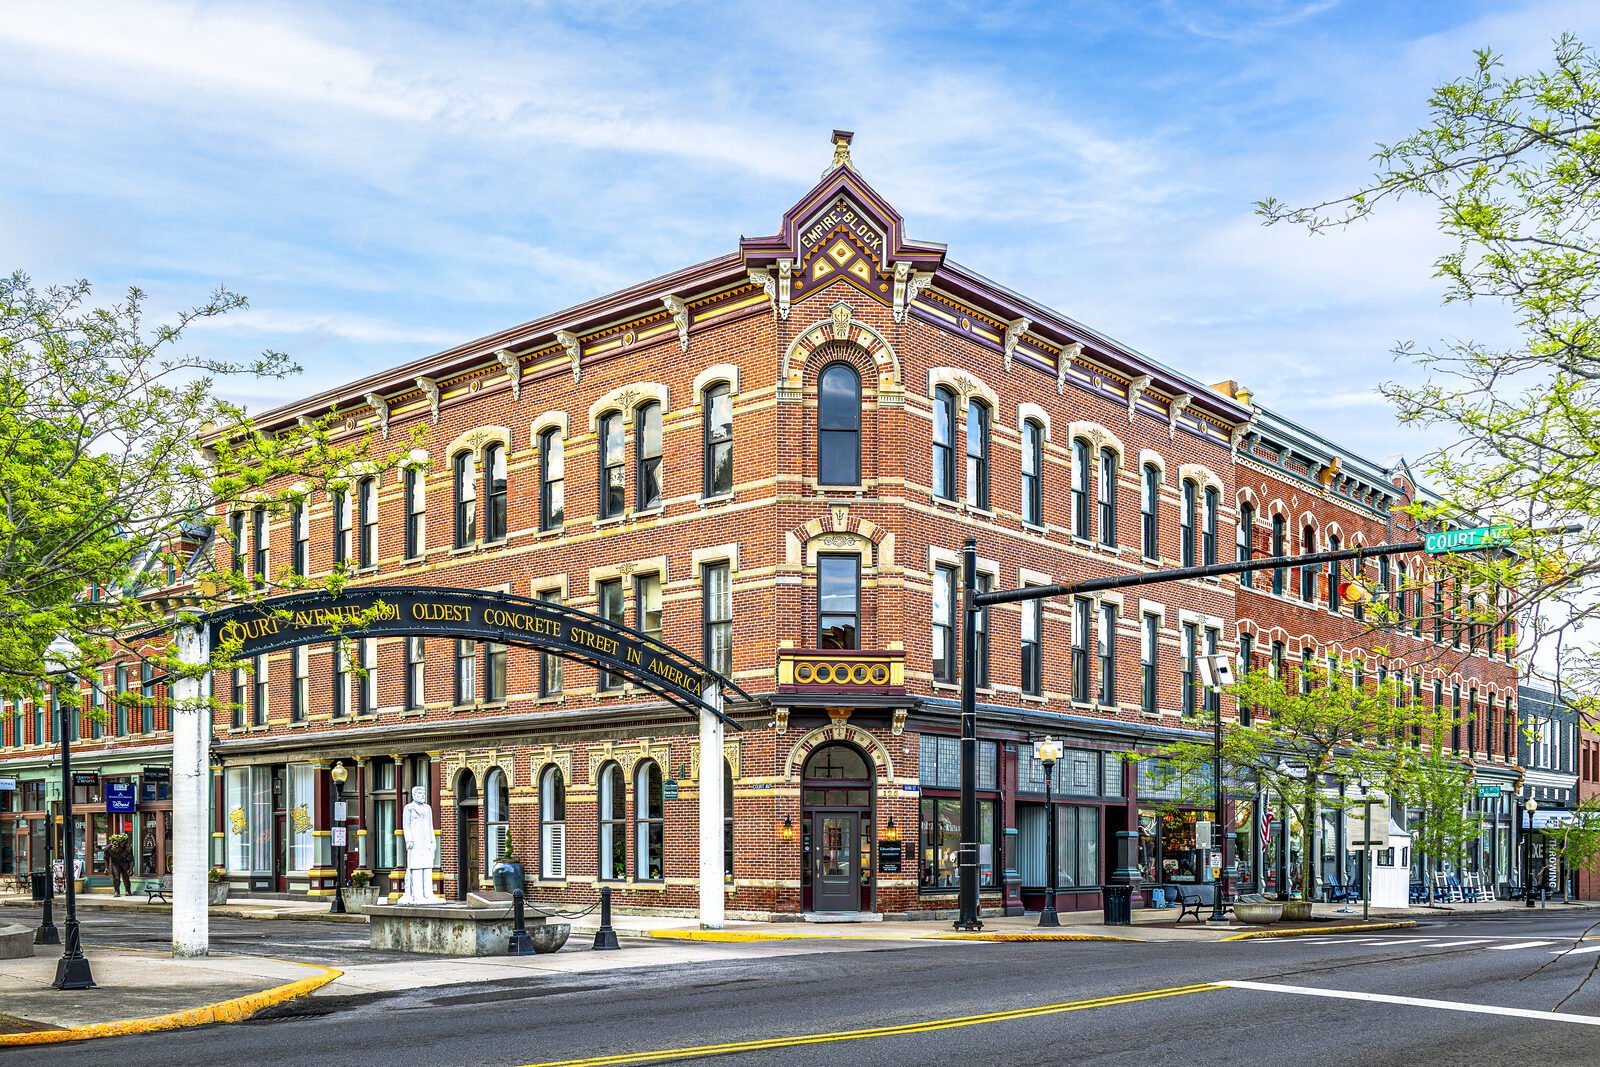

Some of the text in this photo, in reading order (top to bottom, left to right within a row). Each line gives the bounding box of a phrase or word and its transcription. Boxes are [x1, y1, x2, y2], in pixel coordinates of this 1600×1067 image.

[801, 210, 841, 248] EMPIRE
[1427, 531, 1476, 551] COURT
[219, 617, 279, 645] COURT
[295, 605, 361, 629] AVENUE
[412, 603, 472, 622] OLDEST
[483, 608, 561, 637] CONCRETE
[570, 627, 619, 655] STREET
[627, 647, 642, 665] IN
[648, 658, 701, 697] AMERICA
